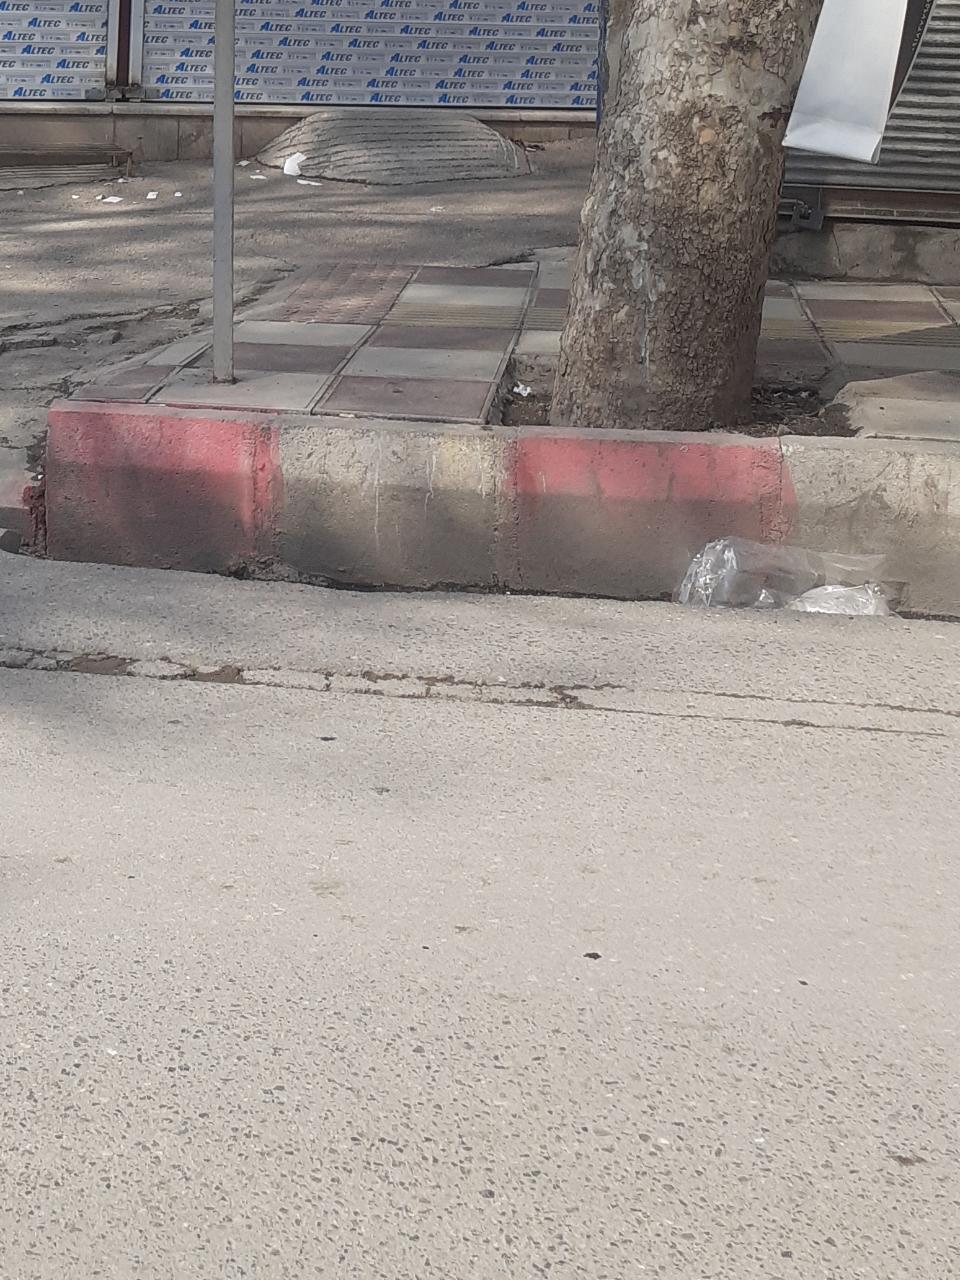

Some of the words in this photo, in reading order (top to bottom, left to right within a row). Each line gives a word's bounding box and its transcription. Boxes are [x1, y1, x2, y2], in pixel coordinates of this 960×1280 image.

[68, 1, 104, 14] ALTEC
[516, 0, 549, 12] ALTEC
[330, 23, 363, 35] ALTEC
[399, 24, 432, 36] ALTEC
[1, 29, 37, 42] ALTEC
[278, 35, 311, 48] ALTEC
[484, 40, 517, 52] ALTEC
[552, 41, 583, 53] ALTEC
[180, 46, 213, 59] ALTEC
[40, 72, 76, 85] ALTEC
[160, 89, 193, 100] ALTEC
[300, 91, 333, 103] ALTEC
[369, 92, 402, 104] ALTEC
[437, 93, 470, 104] ALTEC
[504, 94, 537, 105] ALTEC
